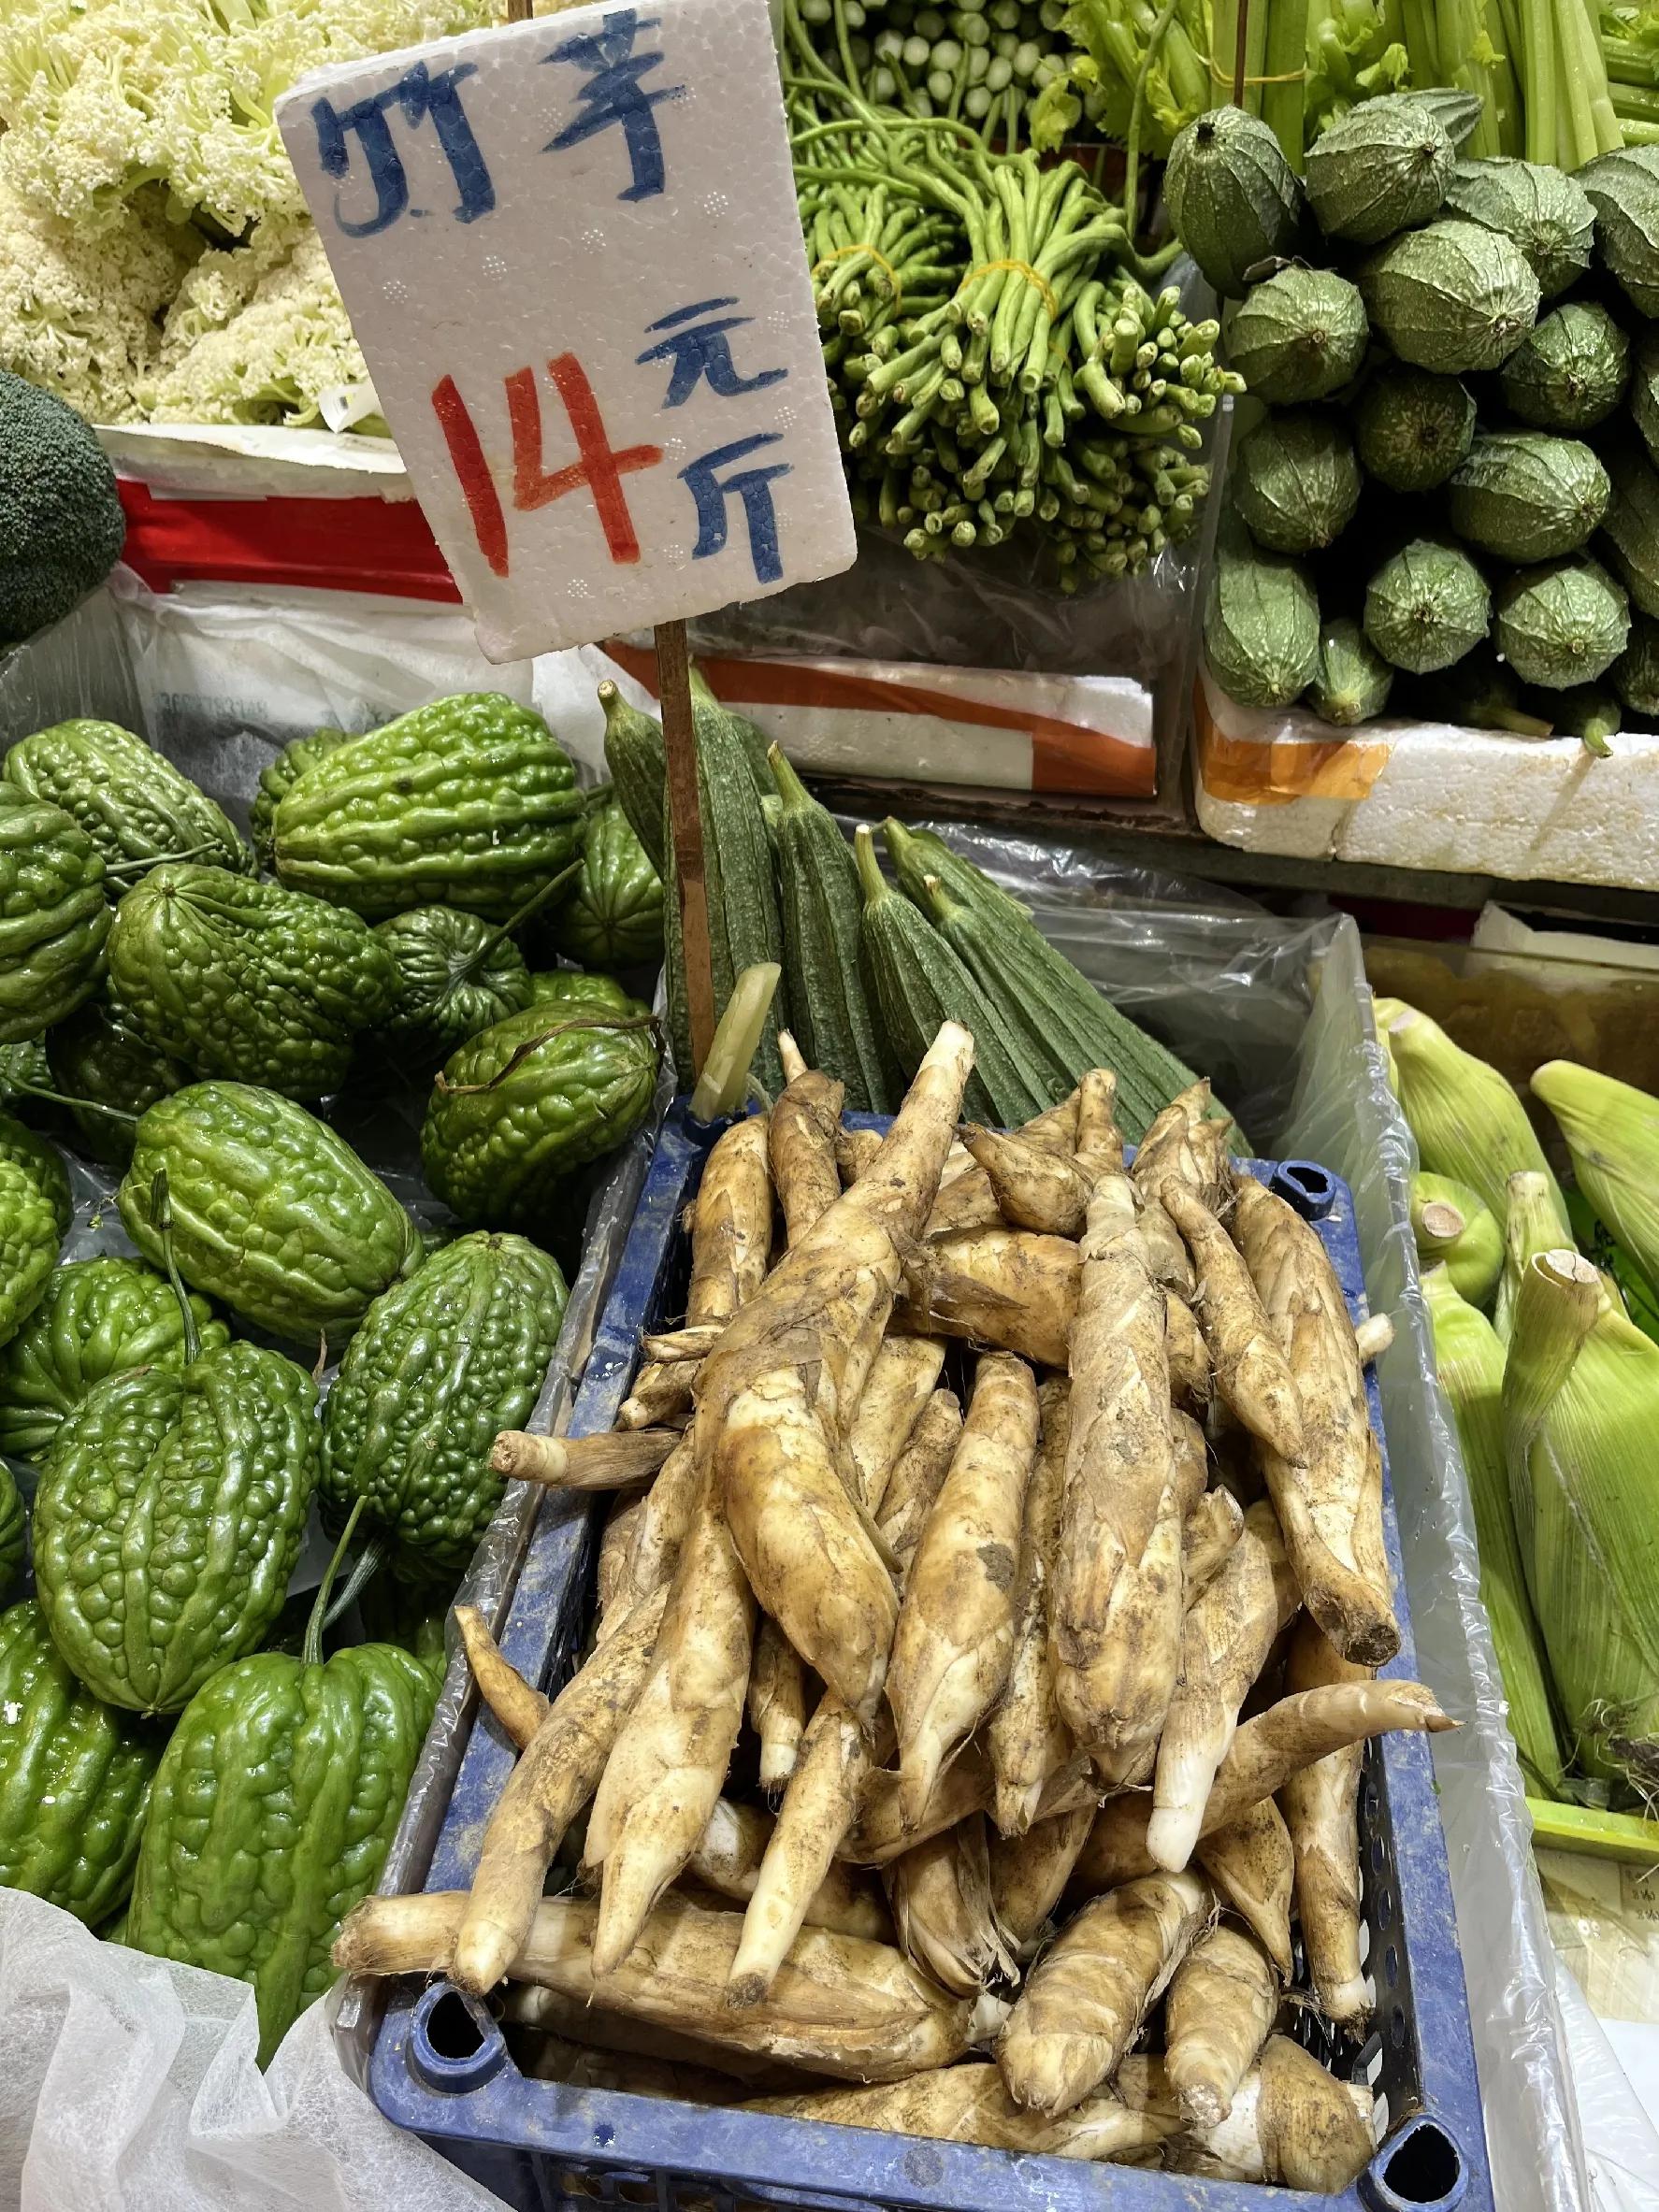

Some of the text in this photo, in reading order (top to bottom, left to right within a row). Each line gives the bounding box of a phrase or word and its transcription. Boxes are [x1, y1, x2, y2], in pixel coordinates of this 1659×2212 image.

[635, 296, 787, 409] 元
[431, 352, 664, 578] 14
[676, 433, 795, 583] 斤
